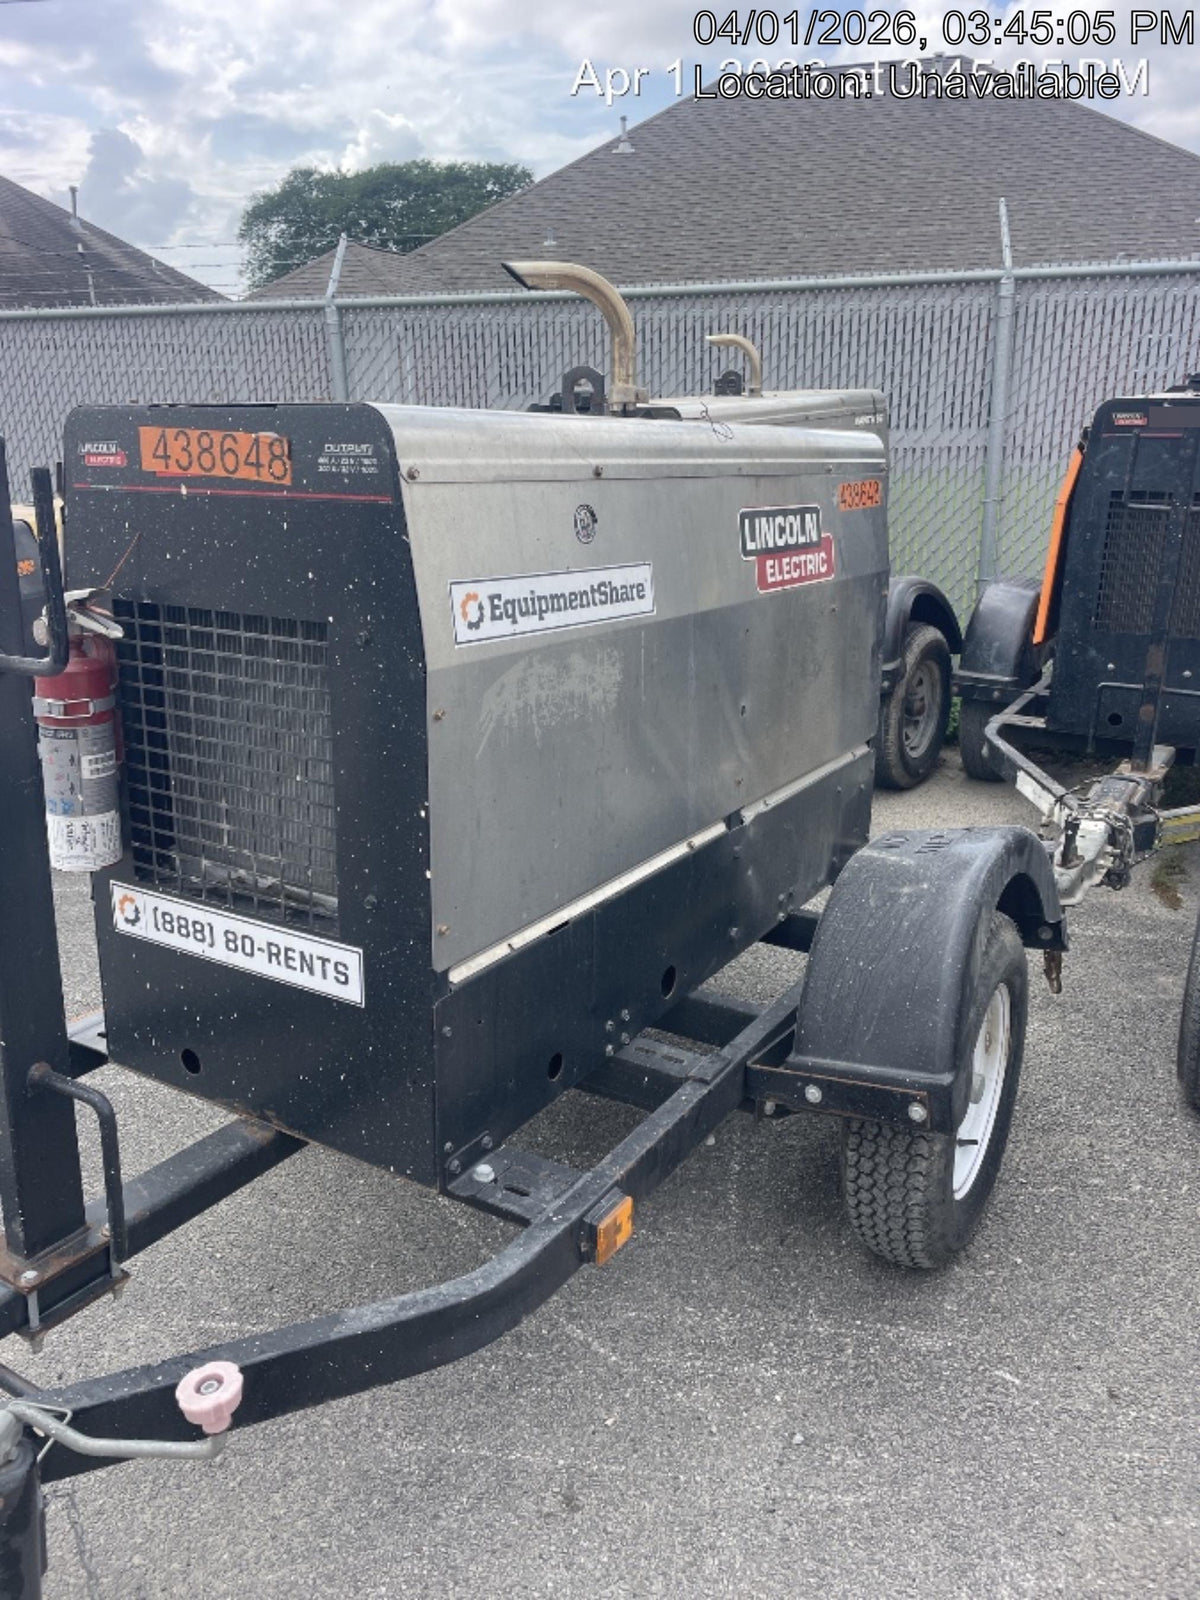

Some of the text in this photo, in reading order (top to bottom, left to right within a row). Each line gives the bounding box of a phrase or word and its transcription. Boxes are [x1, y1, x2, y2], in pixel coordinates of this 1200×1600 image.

[152, 429, 288, 480] 438648
[743, 512, 819, 551] LINCOLN
[765, 551, 828, 584] ELECTRIC
[487, 580, 647, 625] EquipmentShare
[153, 905, 350, 987] (888) 80-RENTS
